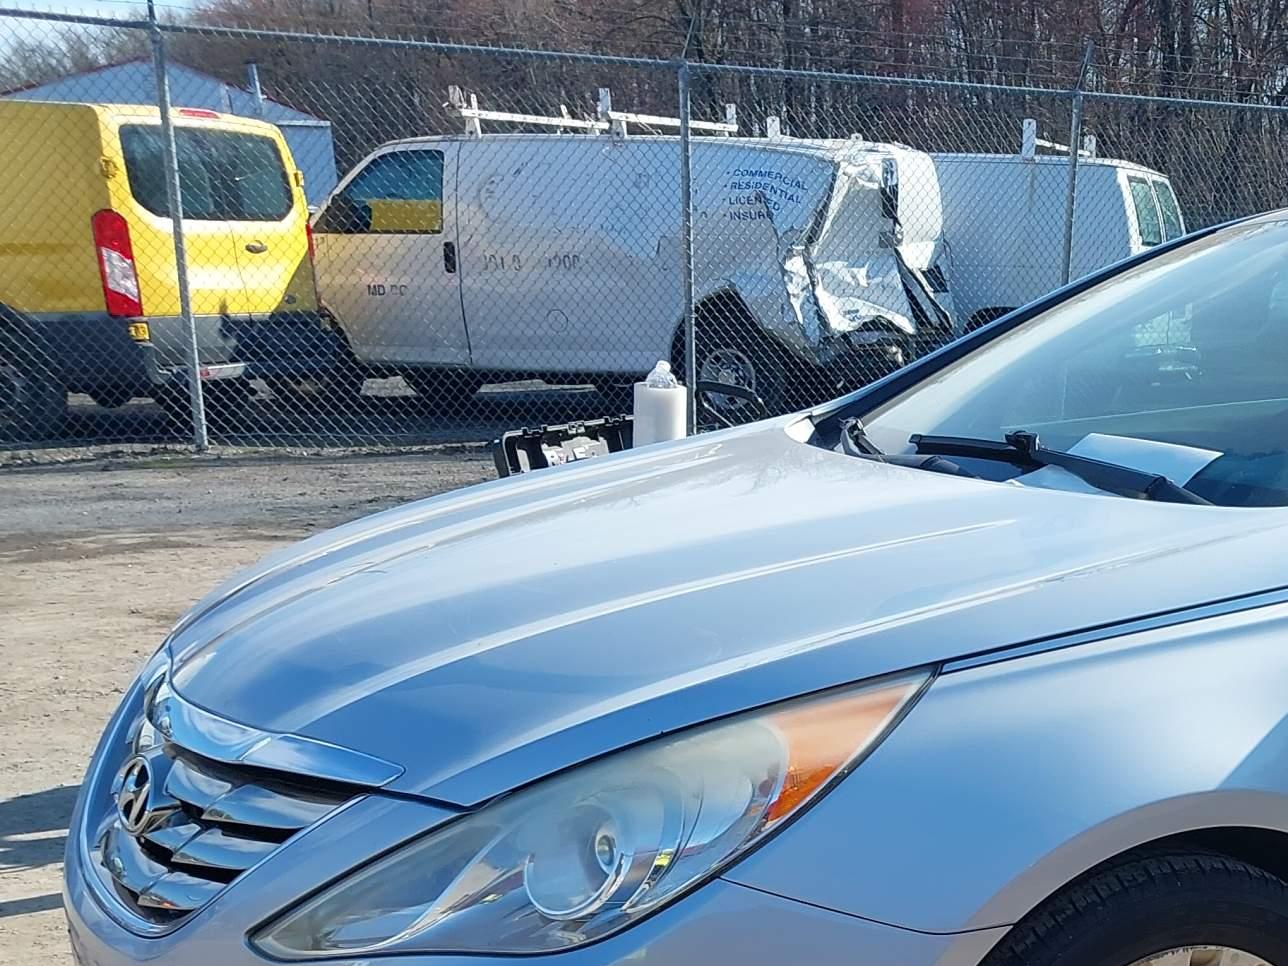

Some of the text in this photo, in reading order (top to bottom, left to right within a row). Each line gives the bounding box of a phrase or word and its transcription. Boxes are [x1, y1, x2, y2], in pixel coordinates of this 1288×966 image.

[733, 169, 808, 191] COMMERCIAL
[730, 181, 801, 204] RESIDENTIAL
[729, 195, 780, 211] LICENED
[367, 284, 386, 297] MD
